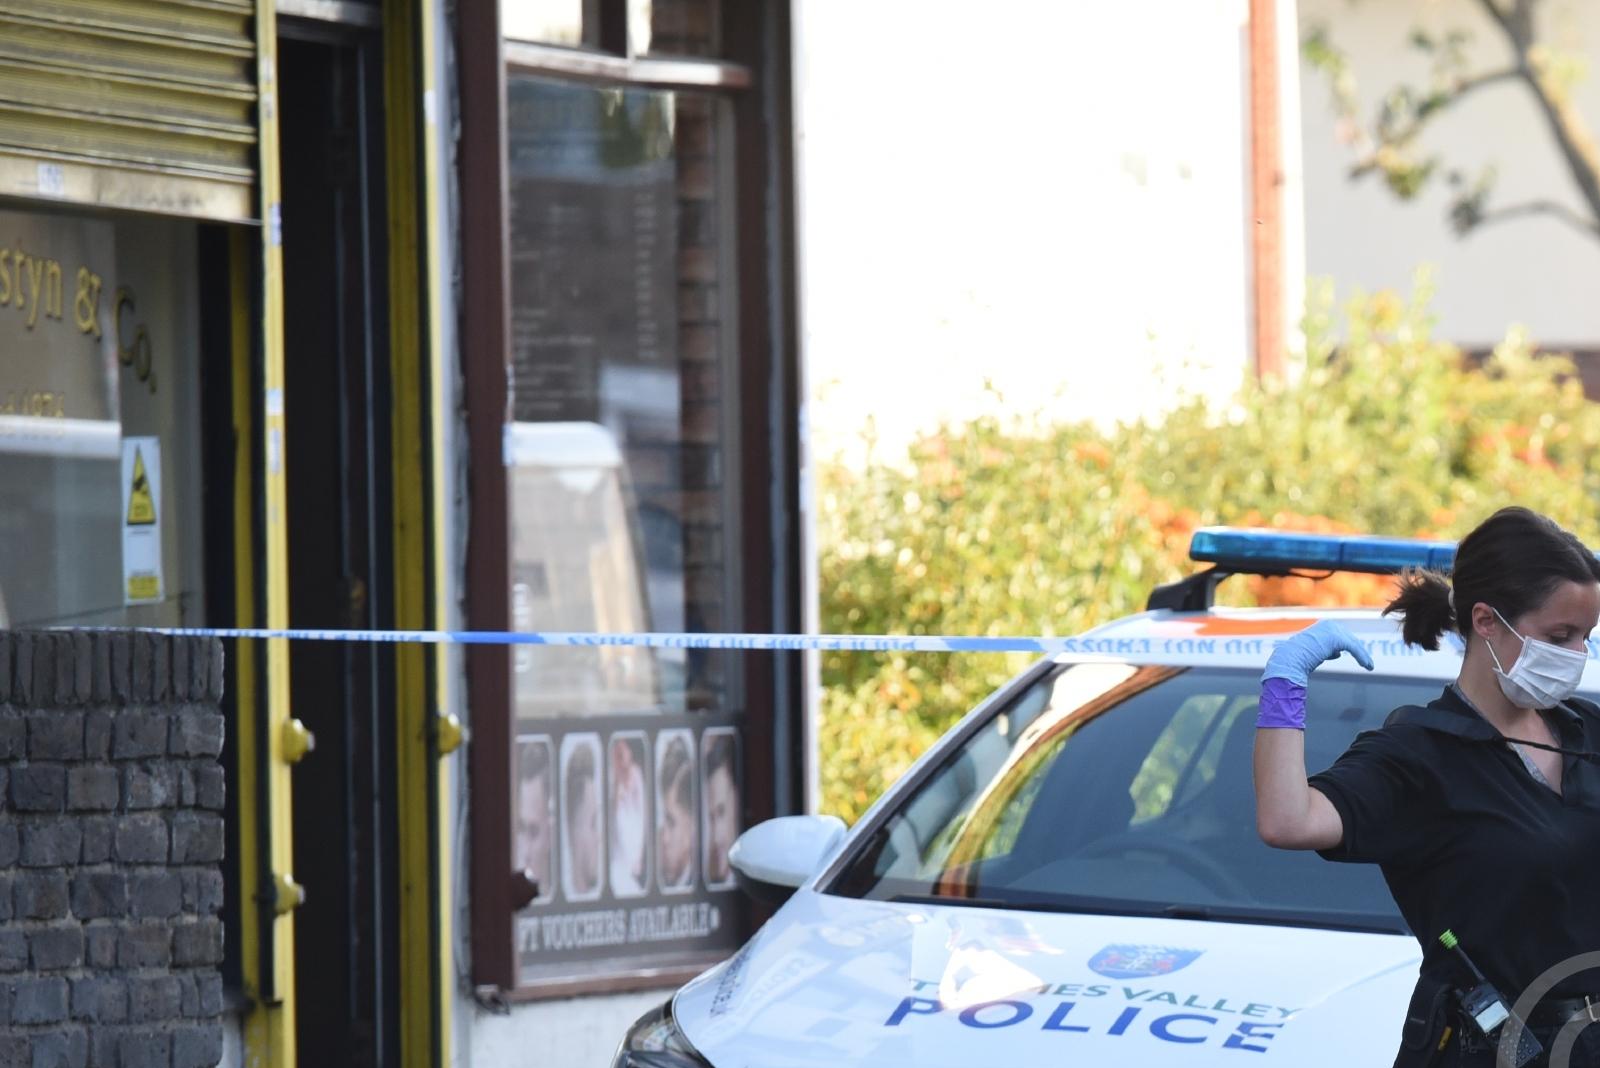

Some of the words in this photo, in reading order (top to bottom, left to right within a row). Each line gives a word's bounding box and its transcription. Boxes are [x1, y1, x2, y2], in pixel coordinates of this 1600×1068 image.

[75, 267, 102, 342] &
[541, 908, 626, 950] VOUCHERS
[884, 996, 1285, 1053] POLICE
[1122, 986, 1305, 1019] VALLEY
